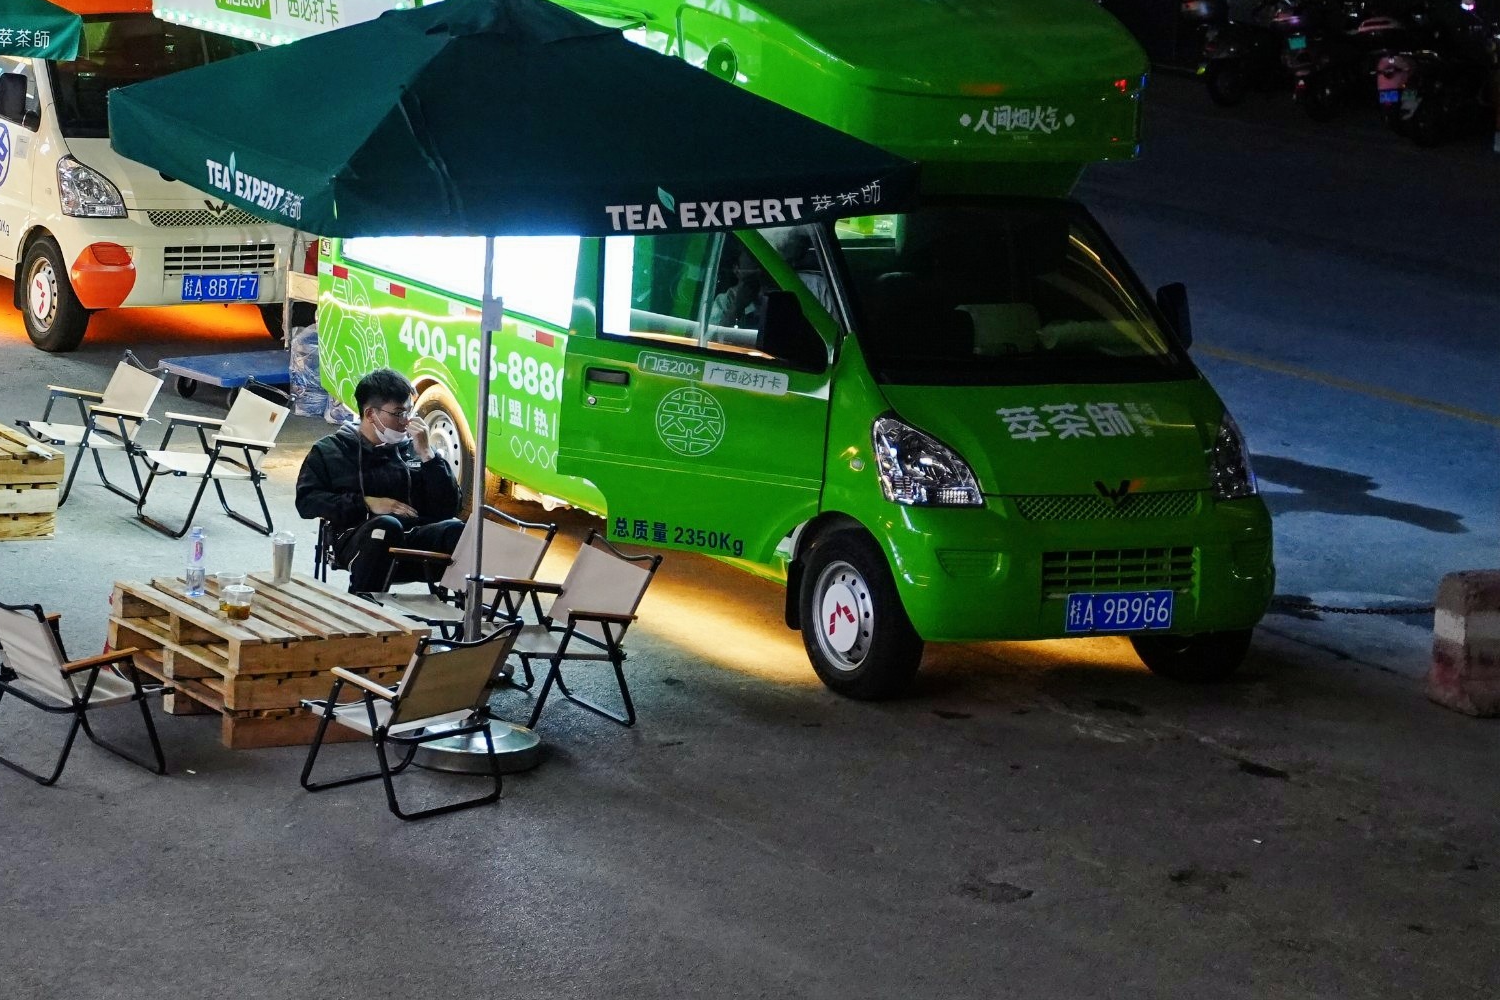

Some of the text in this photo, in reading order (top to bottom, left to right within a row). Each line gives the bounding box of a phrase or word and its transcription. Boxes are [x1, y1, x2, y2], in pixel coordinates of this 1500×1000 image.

[973, 105, 1061, 135] 人间烟火气
[206, 158, 231, 193] TEA
[234, 169, 285, 211] EXPERT
[605, 180, 881, 231] TEA EXPERT 萃茶師
[642, 355, 783, 391] 门店200+ 广西必打卡
[996, 402, 1135, 442] 萃茶師
[612, 516, 745, 556] 总质量 2350Kg
